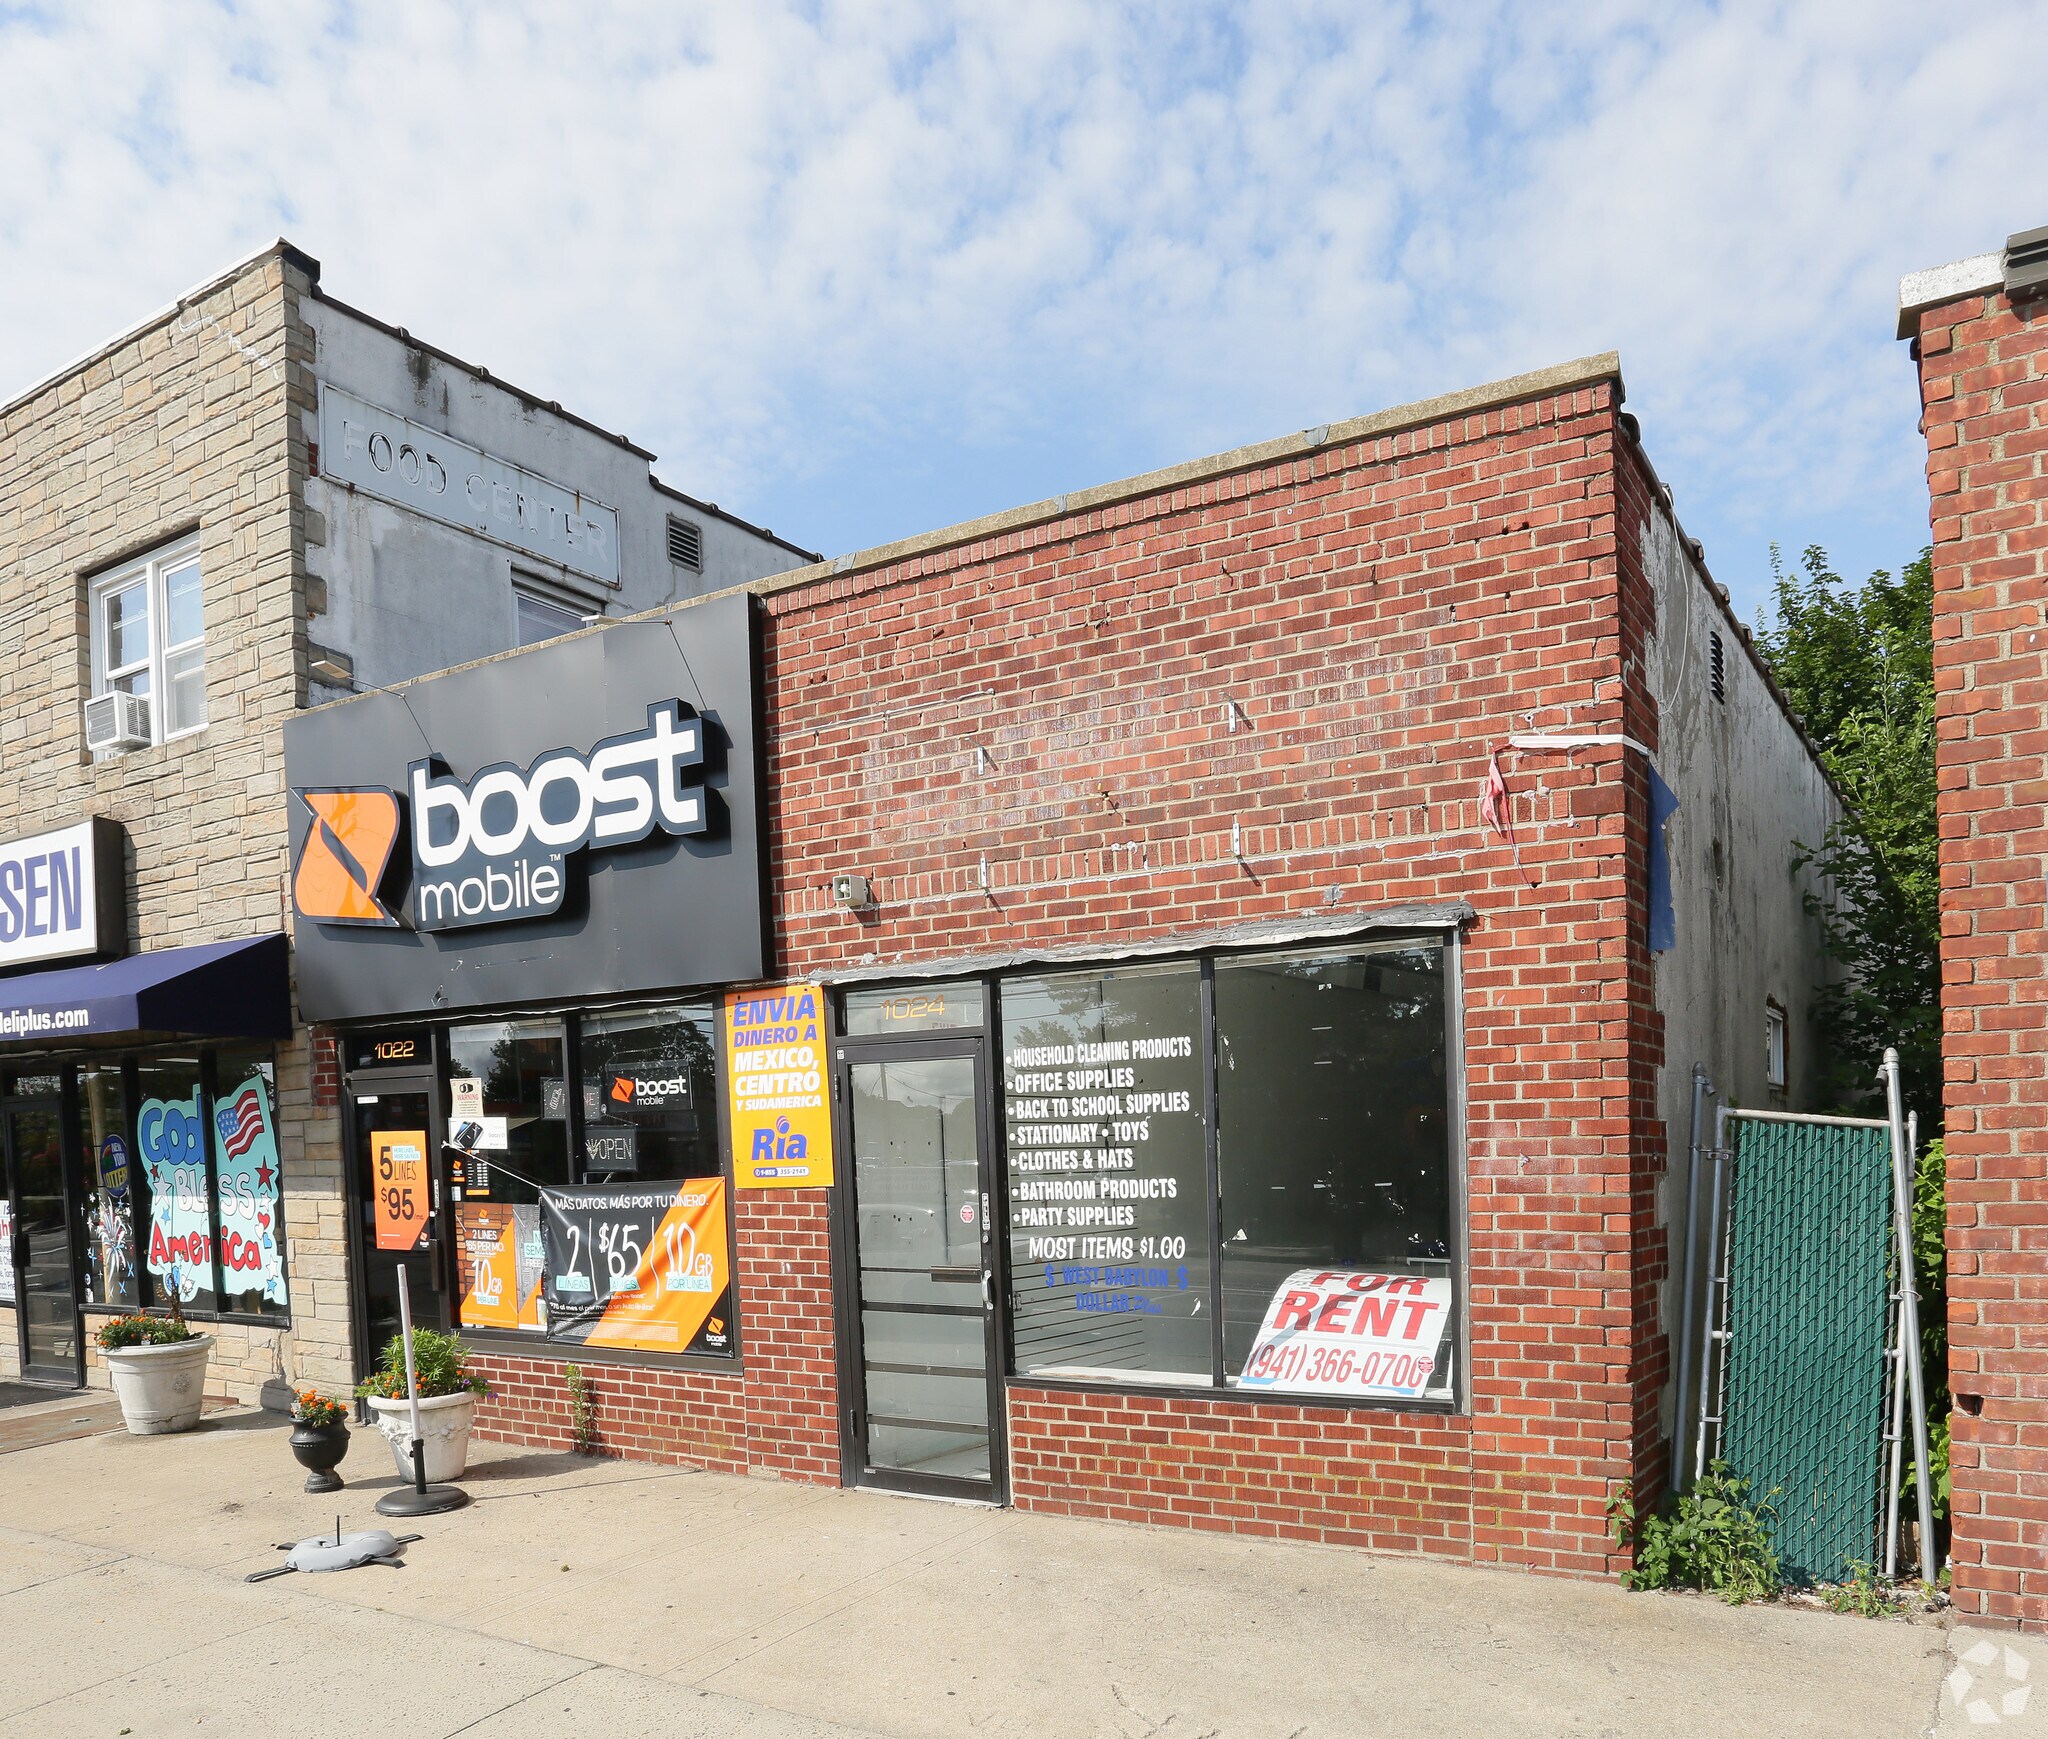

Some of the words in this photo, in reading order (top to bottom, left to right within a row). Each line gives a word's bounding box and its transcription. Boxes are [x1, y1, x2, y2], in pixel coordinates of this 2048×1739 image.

[343, 419, 449, 495] FOOD
[465, 472, 608, 562] CENTER
[413, 709, 700, 868] boost
[420, 859, 561, 922] mobile
[733, 994, 816, 1027] ENVIA
[880, 994, 946, 1021] 1024
[734, 1025, 798, 1047] DINERO
[803, 1024, 817, 1042] A
[374, 1040, 415, 1059] 1022
[734, 1046, 819, 1073] MEXICO,
[1013, 1045, 1074, 1067] HOUSEHOLD
[1077, 1041, 1129, 1063] CLEANING
[1132, 1036, 1191, 1059] PRODUCTS
[635, 1075, 687, 1096] boost
[735, 1070, 820, 1096] CENTRO
[1015, 1072, 1063, 1093] OFFICE
[1067, 1067, 1134, 1090] SUPPLIES
[457, 1093, 479, 1101] WARNING
[637, 1096, 664, 1106] mobile
[736, 1099, 744, 1112] Y
[744, 1095, 822, 1111] SUDAMERICA
[1016, 1099, 1049, 1119] BACK
[1052, 1098, 1068, 1117] TO
[1071, 1095, 1123, 1117] SCHOOL
[1126, 1091, 1190, 1114] SUPPLIES
[751, 1115, 808, 1160] Ria
[1017, 1123, 1098, 1145] STATIONARY
[1112, 1121, 1149, 1142] TOYS
[599, 1137, 632, 1160] OPEN
[1018, 1151, 1078, 1171] CLOTHES
[1082, 1149, 1093, 1169] &
[1098, 1148, 1133, 1168] HATS
[380, 1146, 393, 1180] 5
[394, 1161, 417, 1180] LINES
[1020, 1180, 1096, 1201] BATHROOM
[1100, 1177, 1177, 1199] PRODUCTS
[381, 1187, 414, 1220] $95
[555, 1196, 575, 1210] MÁS
[610, 1194, 631, 1209] MÁS
[632, 1196, 652, 1208] POR
[654, 1195, 668, 1208] TU
[670, 1194, 709, 1207] DINERO.
[1021, 1207, 1065, 1226] PARTY
[1067, 1205, 1134, 1226] SUPPLIES
[150, 1220, 262, 1272] America
[472, 1229, 477, 1240] 2
[478, 1230, 498, 1240] LINES
[477, 1241, 491, 1251] PER
[567, 1225, 582, 1277] 2
[599, 1222, 642, 1278] $65
[662, 1222, 696, 1277] 10
[695, 1253, 713, 1277] GB
[1028, 1236, 1076, 1259] MOST
[1082, 1236, 1134, 1260] ITEMS
[1139, 1236, 1186, 1260] $1.00
[472, 1258, 492, 1297] 10
[491, 1277, 503, 1294] GB
[668, 1279, 685, 1290] POR
[687, 1277, 709, 1290] LÍNEA
[1062, 1265, 1100, 1285] WEST
[1105, 1267, 1168, 1287] BABYLON
[1310, 1271, 1431, 1296] FOR
[1076, 1292, 1130, 1313] DOLLAR
[1272, 1290, 1440, 1340] RENT
[706, 1333, 727, 1343] boost
